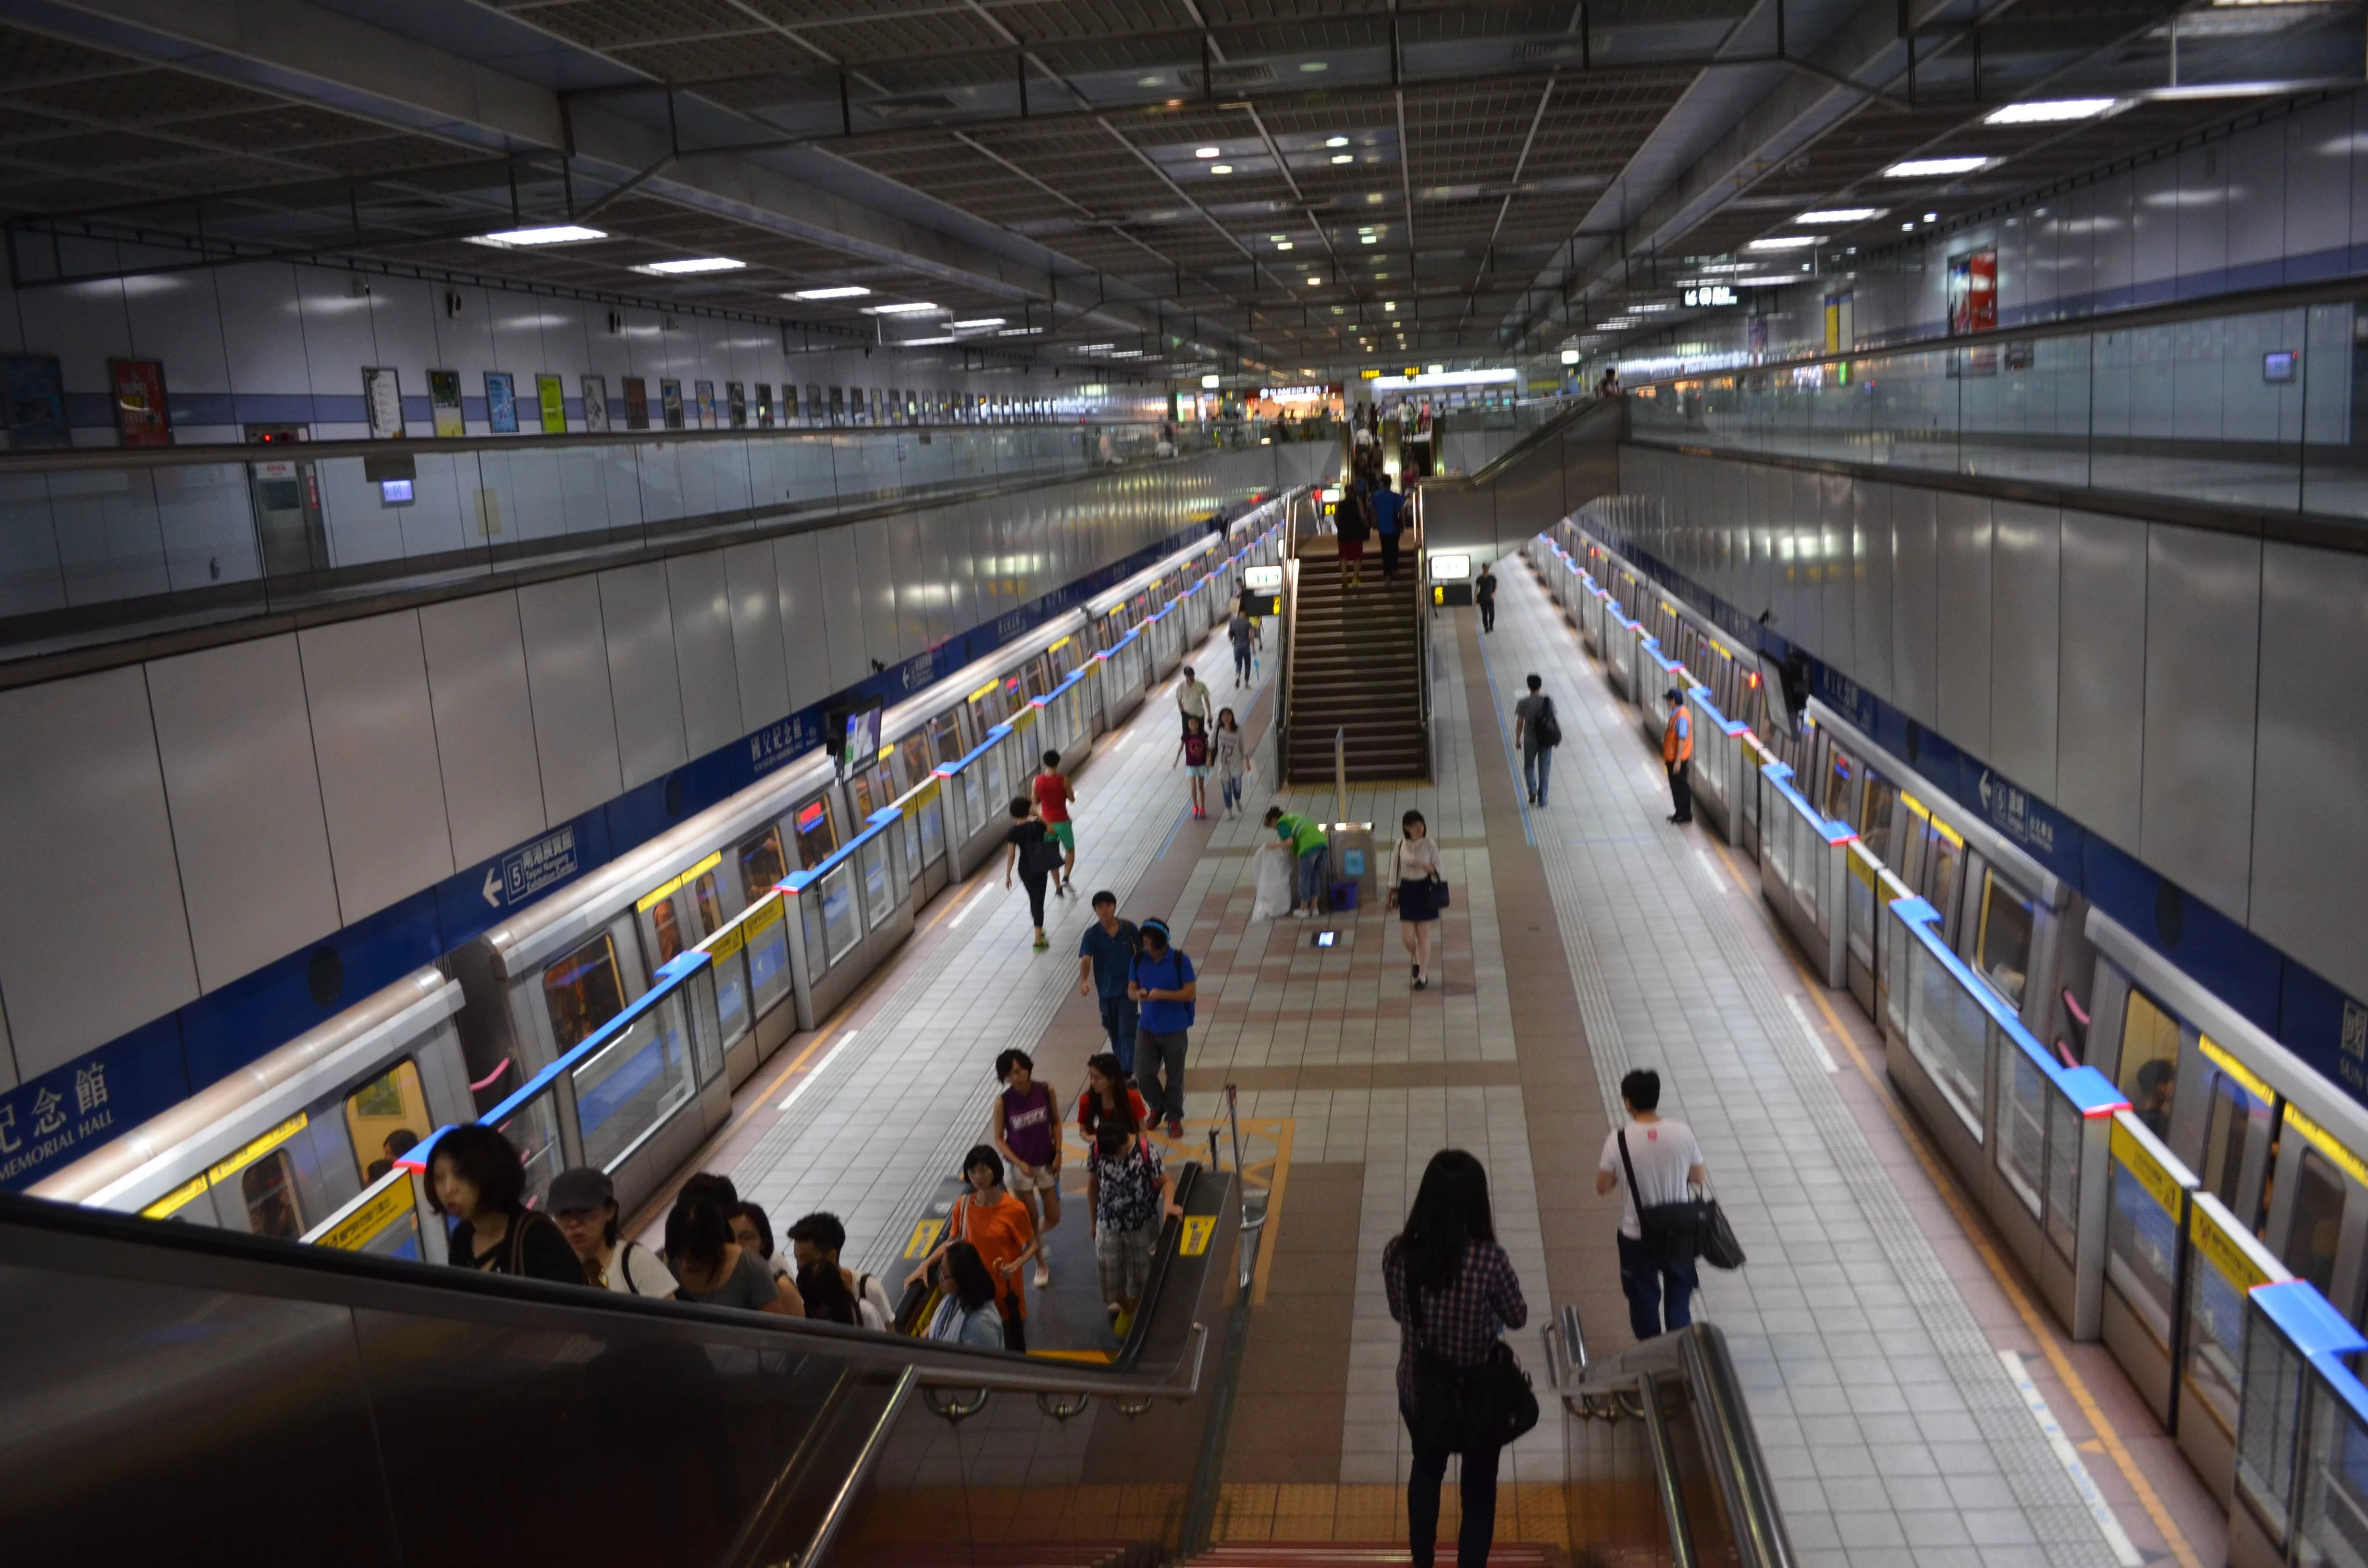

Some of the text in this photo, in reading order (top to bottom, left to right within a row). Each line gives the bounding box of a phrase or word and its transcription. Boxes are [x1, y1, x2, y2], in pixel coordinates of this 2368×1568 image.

[123, 411, 164, 425] FESTIAL
[513, 865, 521, 888] 5
[0, 1109, 114, 1181] MEMORIAL HALL
